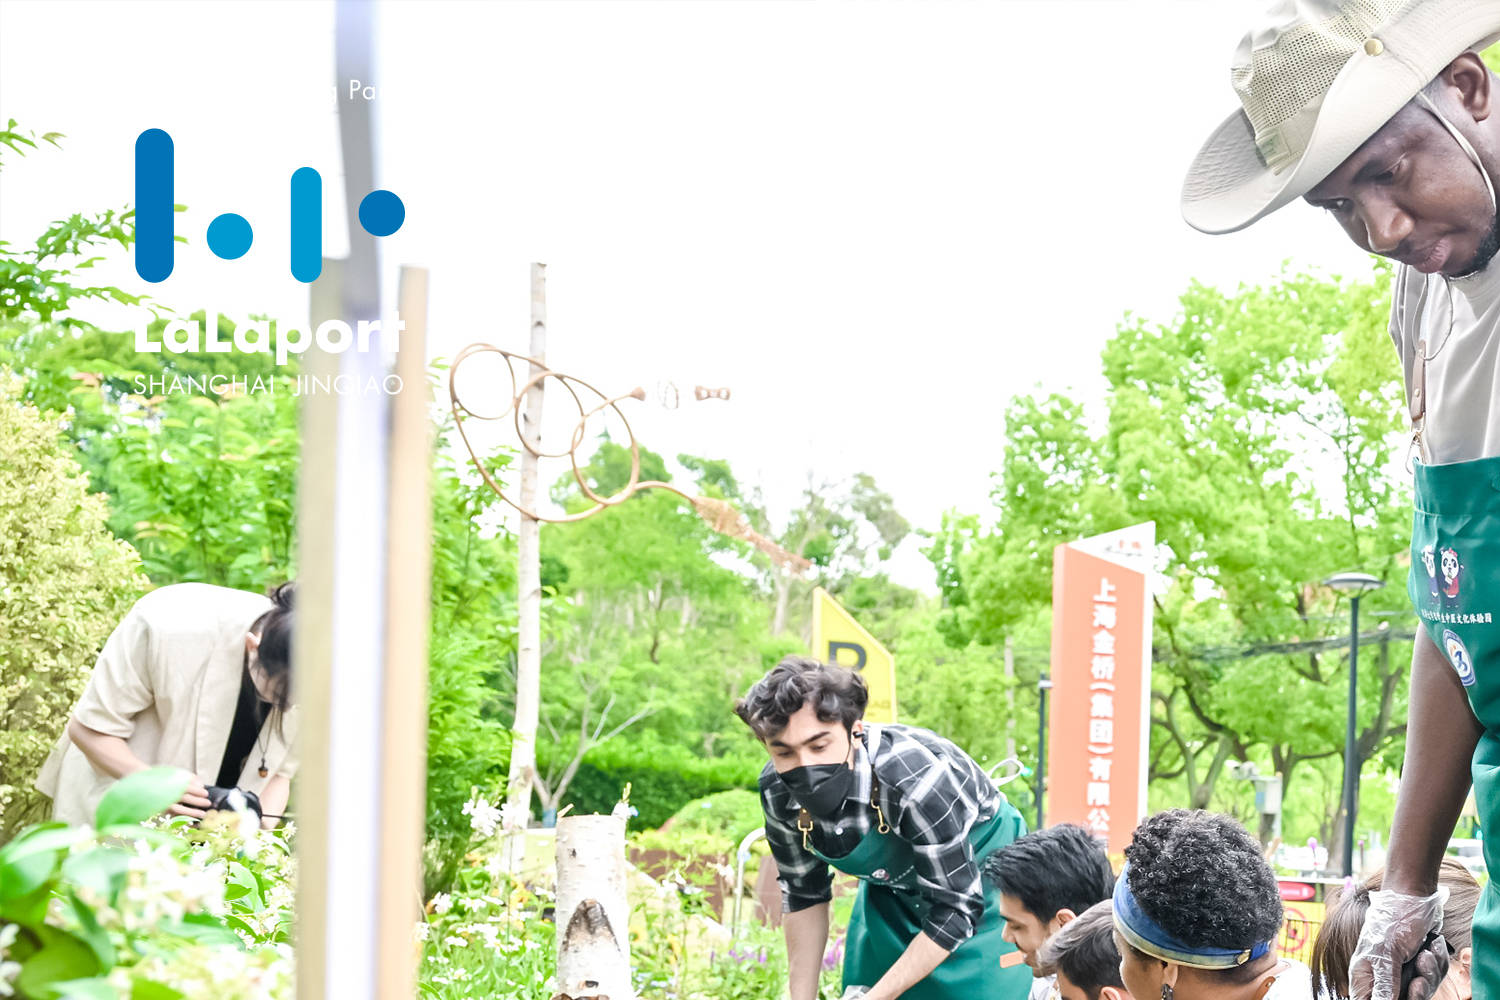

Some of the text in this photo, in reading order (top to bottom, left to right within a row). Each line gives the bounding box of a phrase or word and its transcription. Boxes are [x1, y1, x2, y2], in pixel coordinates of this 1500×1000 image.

[1086, 577, 1117, 852] 上海金桥（集团）有限公
